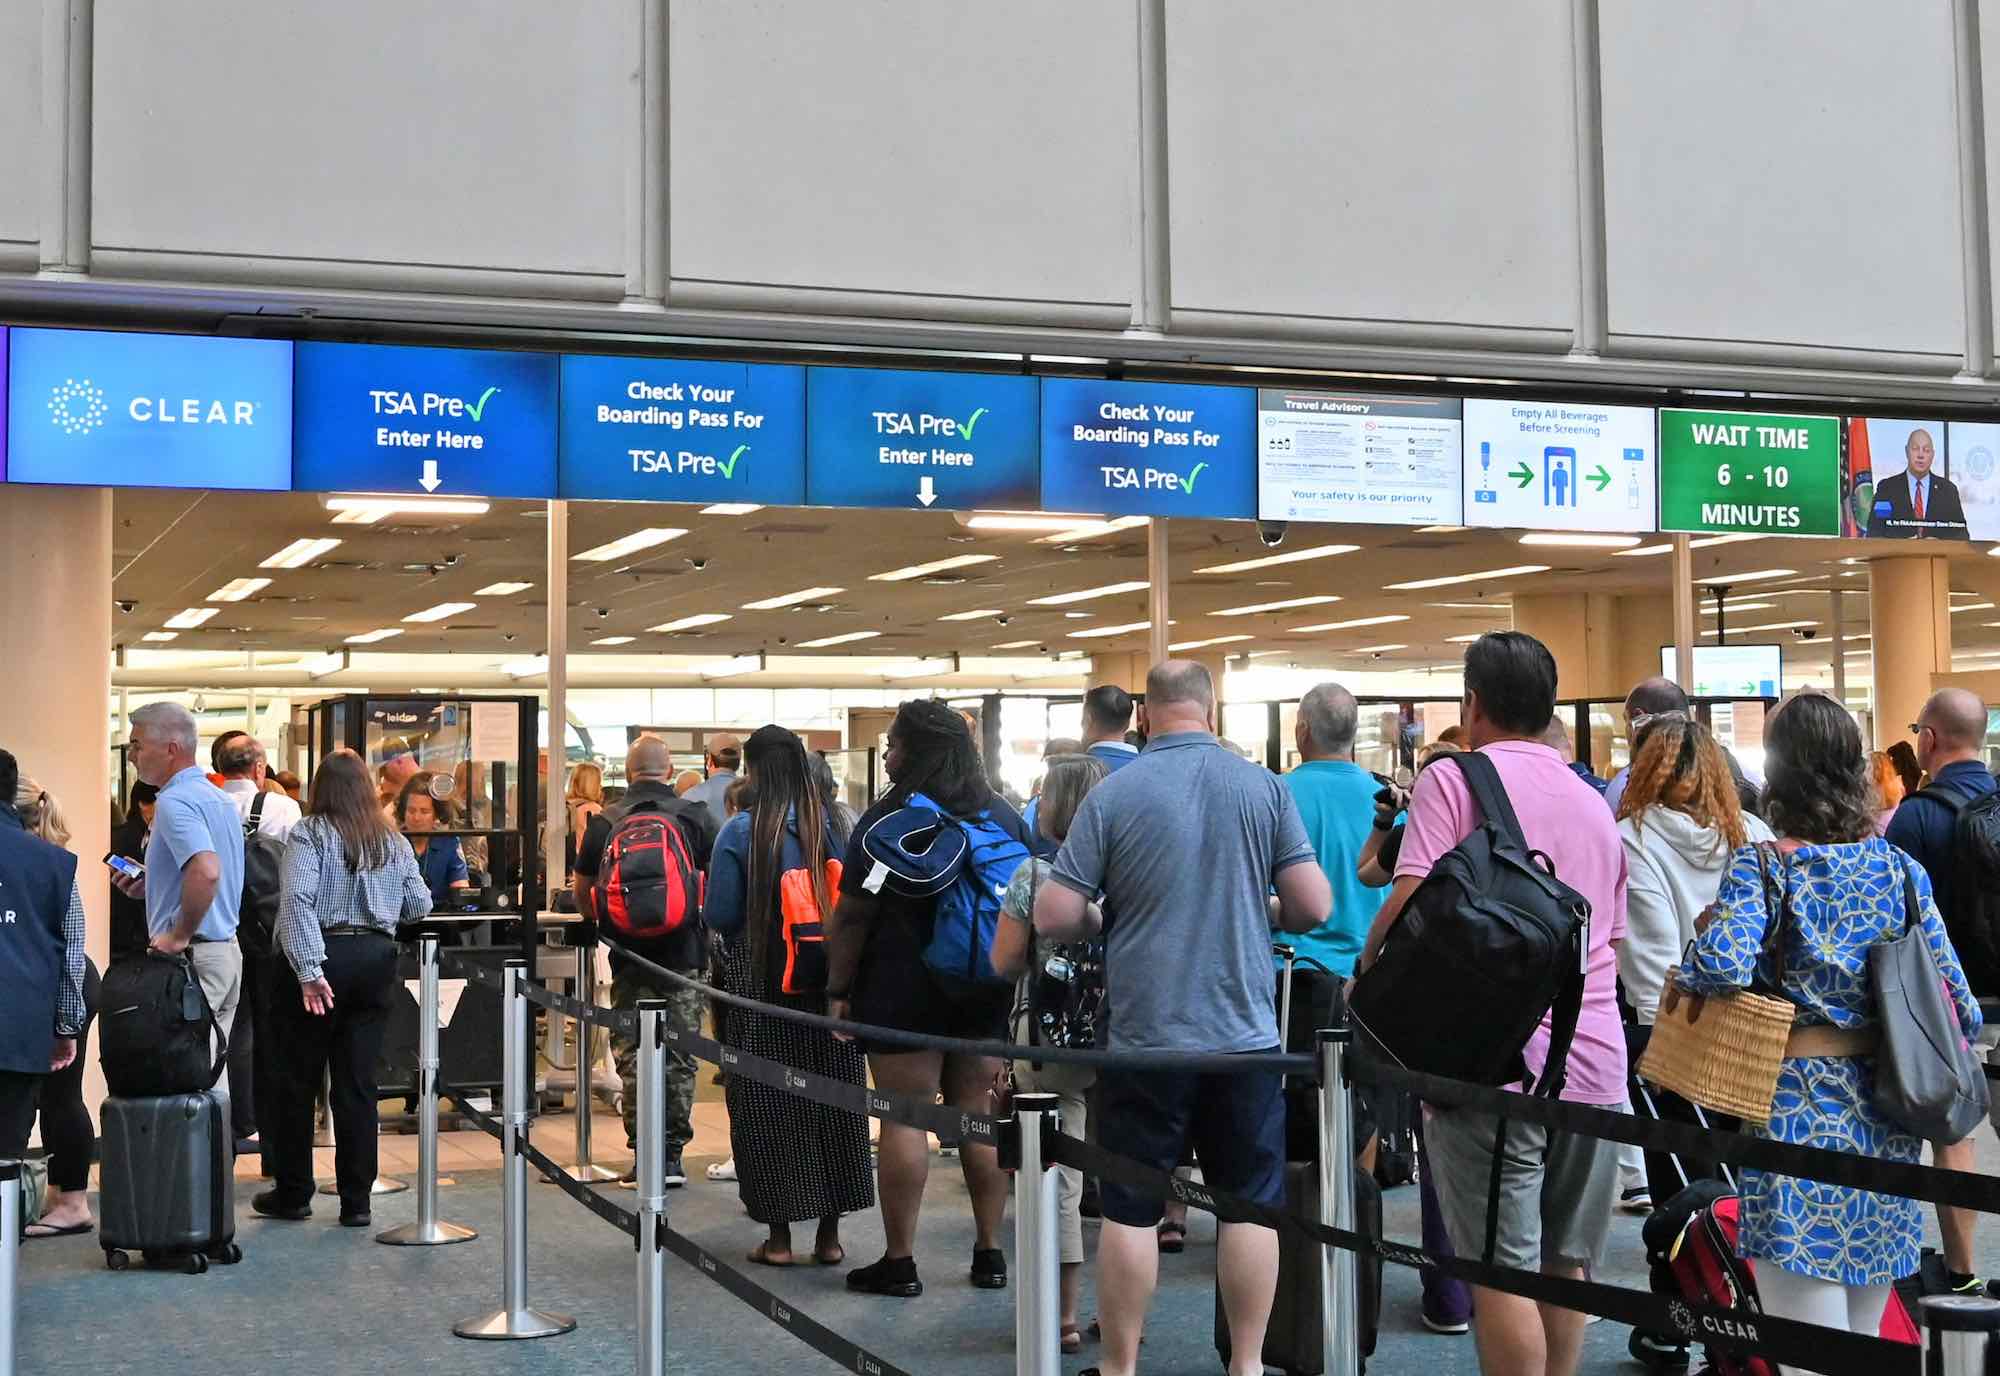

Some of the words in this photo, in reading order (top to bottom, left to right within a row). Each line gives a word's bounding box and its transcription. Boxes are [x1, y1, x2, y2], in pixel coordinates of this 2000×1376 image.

[369, 390, 417, 416] TSA
[627, 381, 684, 401] Check
[687, 384, 734, 403] Your
[129, 397, 254, 425] CLEAR
[597, 405, 683, 430] Boarding
[688, 409, 729, 427] Pass
[734, 411, 764, 428] For
[1099, 402, 1150, 421] Check
[1153, 405, 1194, 423] Your
[1284, 400, 1320, 411] Travel
[1321, 402, 1370, 414] Advisory
[1511, 408, 1543, 420] Empty
[1545, 409, 1558, 419] All
[1560, 410, 1608, 423] Beverages
[873, 412, 915, 434] TSA
[1520, 422, 1552, 433] Before
[1554, 424, 1600, 437] Screening
[377, 428, 431, 448] Enter
[436, 430, 484, 449] Here
[1073, 424, 1150, 447] Boarding
[1153, 427, 1190, 445] Pass
[1194, 430, 1220, 447] For
[1691, 423, 1751, 447] WAIT
[1756, 426, 1809, 450] TIME
[628, 449, 673, 473] TSA
[879, 447, 927, 465] Enter
[932, 449, 974, 466] Here
[1100, 466, 1140, 488] TSA
[1717, 463, 1731, 486] 6
[1763, 465, 1789, 488] 10
[1292, 490, 1316, 500] Your
[1321, 491, 1355, 502] safety
[1358, 492, 1367, 501] is
[1369, 494, 1386, 502] our
[1391, 493, 1432, 504] priority
[1702, 503, 1801, 527] MINUTES
[873, 1098, 890, 1112] CLEAR
[971, 1121, 991, 1136] CLEAR
[1702, 1315, 1759, 1342] CLEAR
